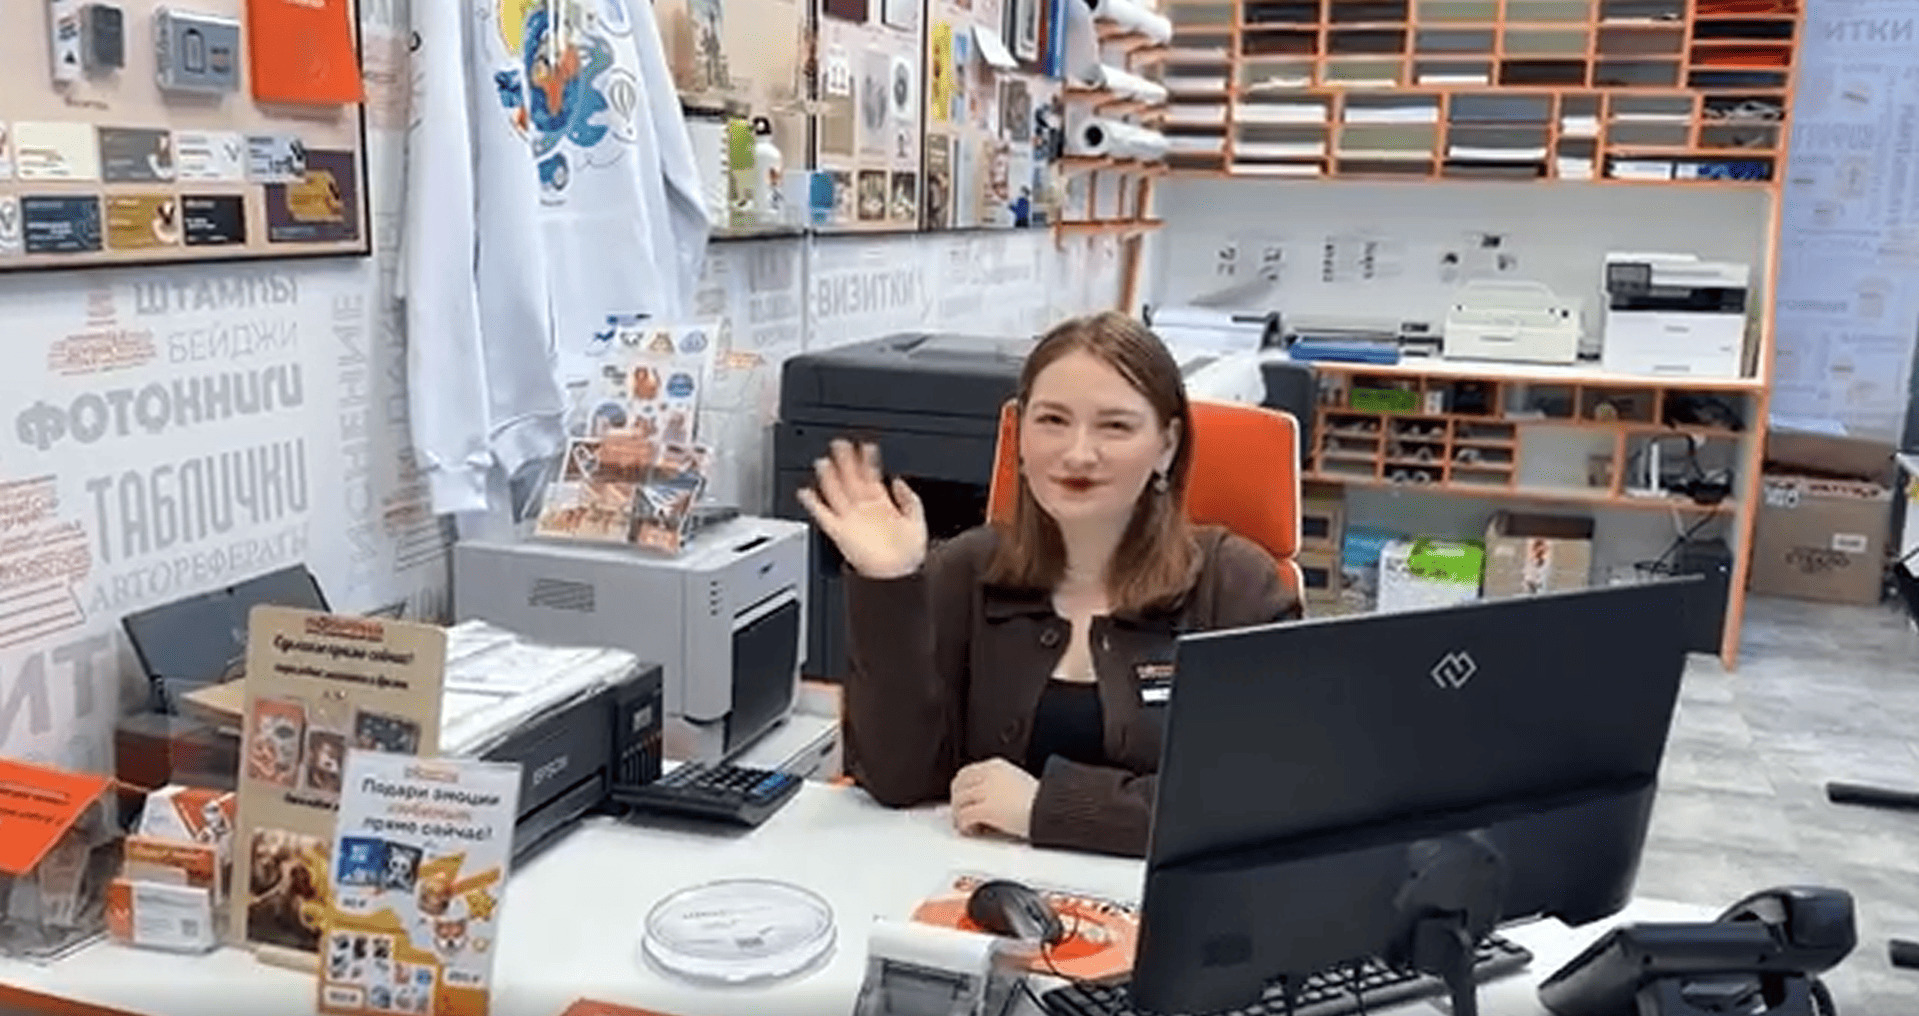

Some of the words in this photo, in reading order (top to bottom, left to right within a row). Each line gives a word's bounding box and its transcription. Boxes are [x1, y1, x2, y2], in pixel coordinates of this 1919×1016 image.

[133, 275, 298, 316] ШТАМПЫ
[816, 265, 916, 318] ВИЗИТКИ
[167, 320, 299, 364] БЕЙДЖИ
[15, 363, 304, 450] ФОТОКНИГИ
[86, 437, 309, 564] ТАБЛИЧКИ
[362, 777, 429, 800] Подари
[432, 787, 499, 807] эмоции
[363, 816, 417, 836] прямо
[421, 821, 493, 841] сейчас!
